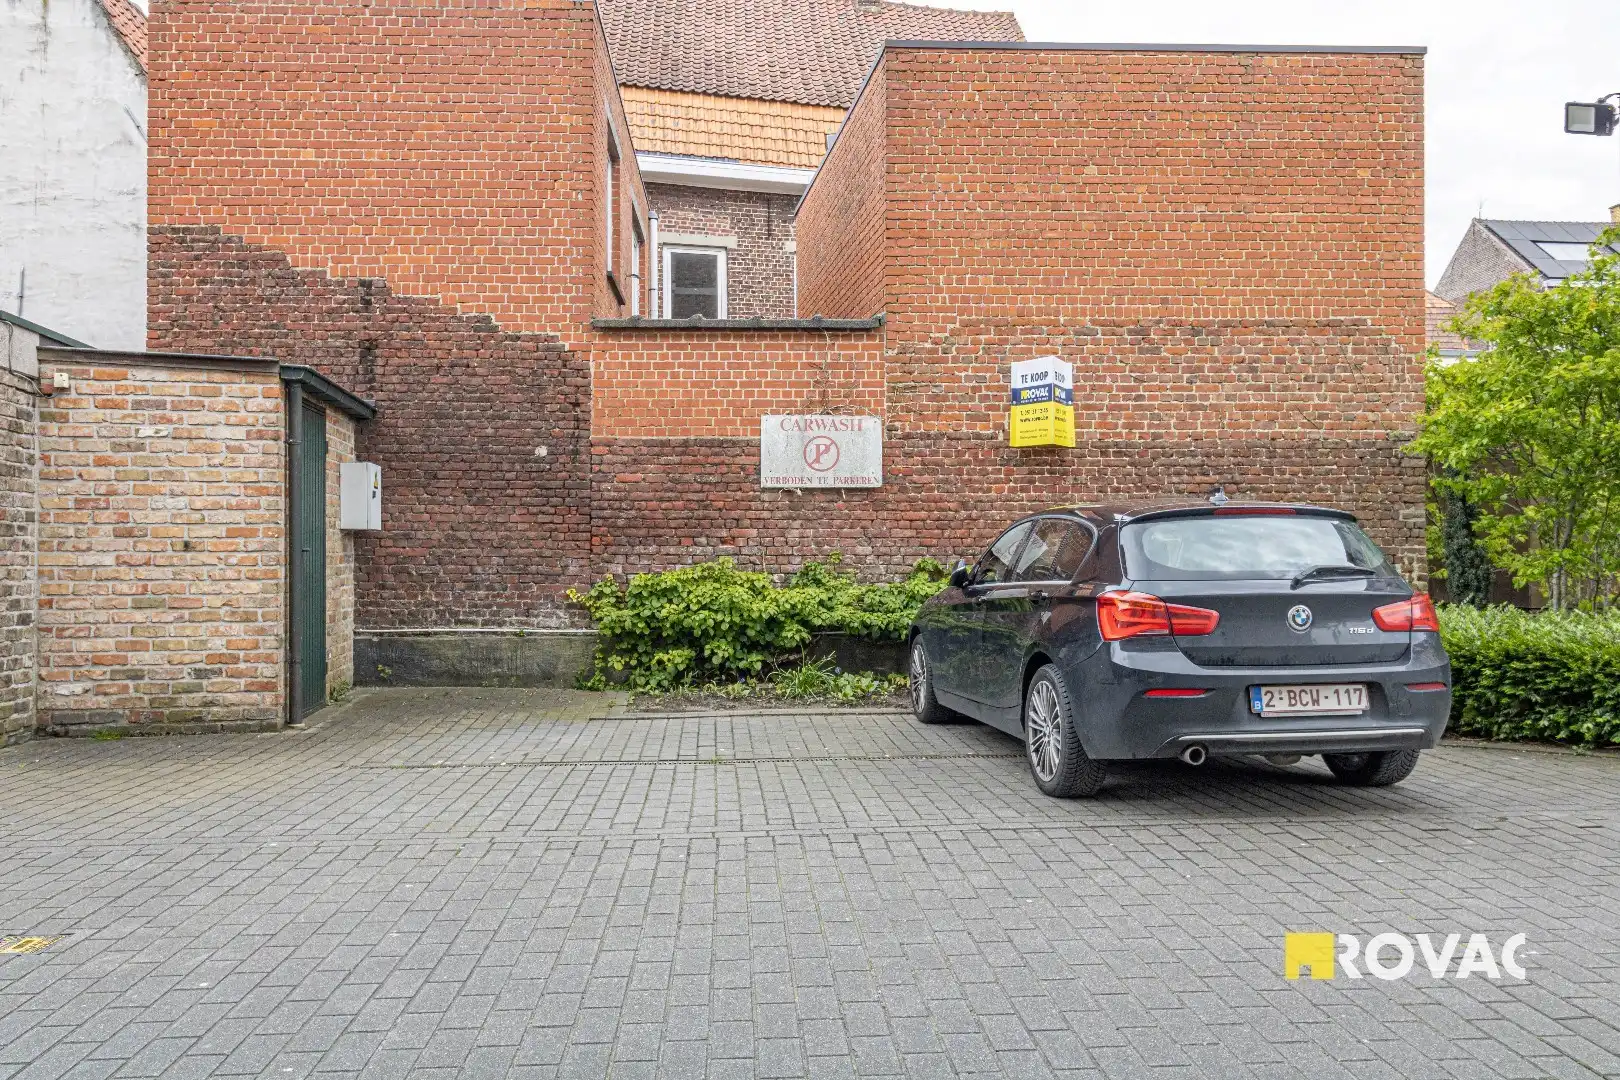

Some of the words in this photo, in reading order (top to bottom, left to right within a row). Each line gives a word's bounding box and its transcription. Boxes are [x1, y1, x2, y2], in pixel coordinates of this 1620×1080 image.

[1021, 374, 1028, 384] TE
[1031, 371, 1048, 382] KOOP
[1026, 387, 1048, 399] ROVAC
[780, 418, 863, 432] CARWASH
[814, 443, 831, 464] P
[763, 476, 813, 485] VERBODEN
[816, 476, 829, 485] TE
[833, 476, 880, 485] PARKEREN
[1254, 701, 1262, 710] B
